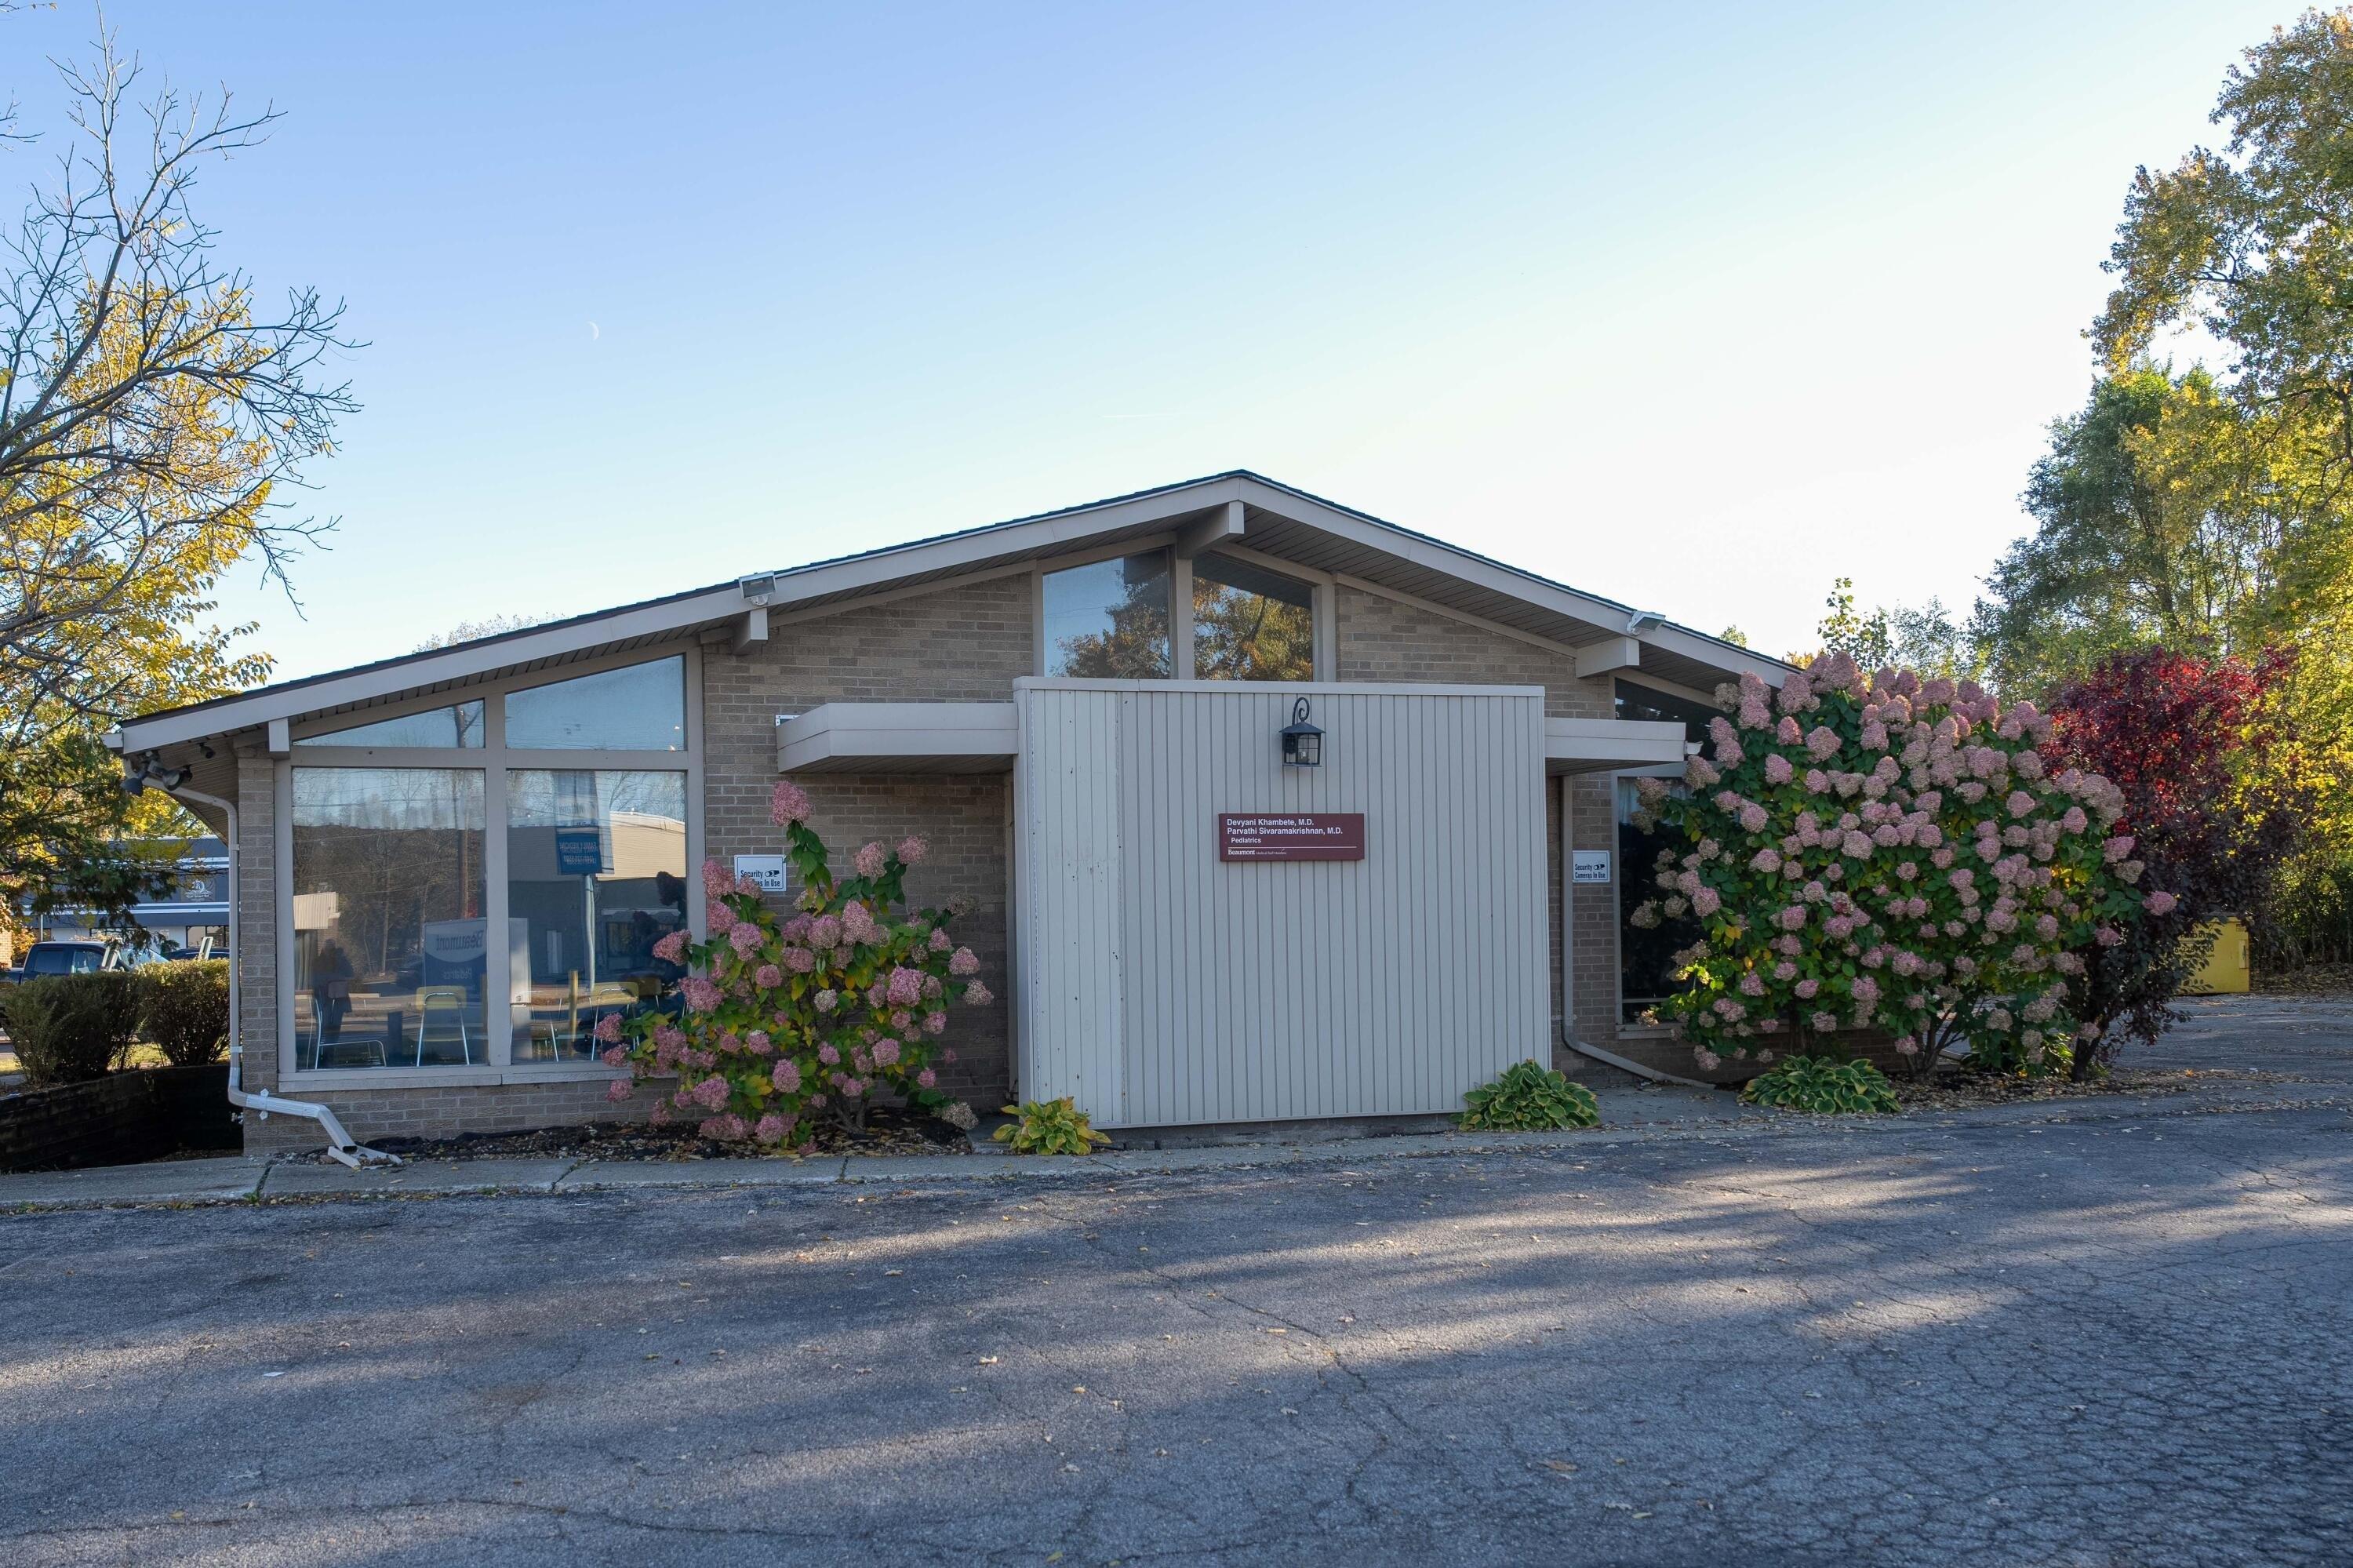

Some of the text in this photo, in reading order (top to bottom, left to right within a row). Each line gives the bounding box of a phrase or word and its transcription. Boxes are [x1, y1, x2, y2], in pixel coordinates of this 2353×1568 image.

[1227, 818, 1257, 827] Devyani
[1259, 827, 1326, 835] Sivaramakrishnan,
[740, 869, 763, 879] Security
